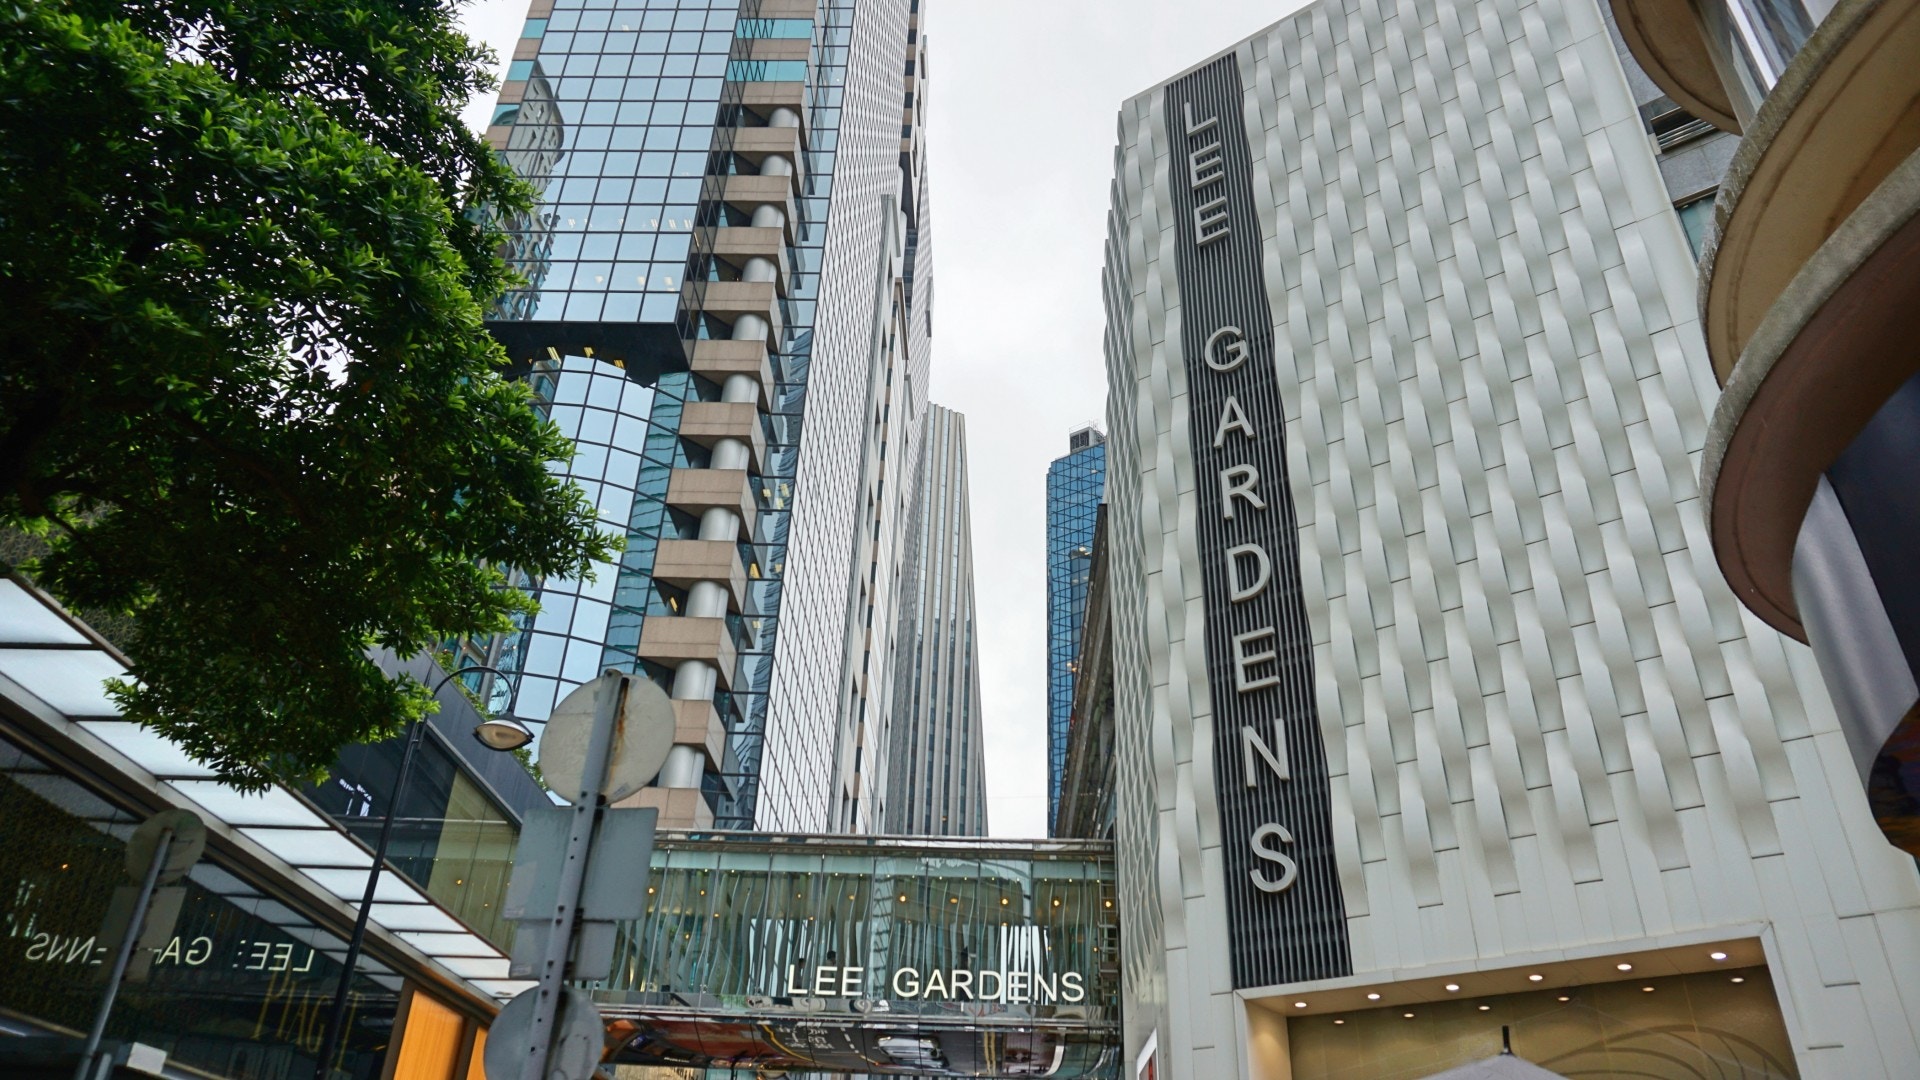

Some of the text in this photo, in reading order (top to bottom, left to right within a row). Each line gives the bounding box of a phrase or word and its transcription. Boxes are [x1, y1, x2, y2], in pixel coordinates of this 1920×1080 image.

[1183, 101, 1298, 894] LEE GARDENS
[251, 946, 367, 1074] PIAGT
[787, 964, 1086, 1002] LEE GARDENS
